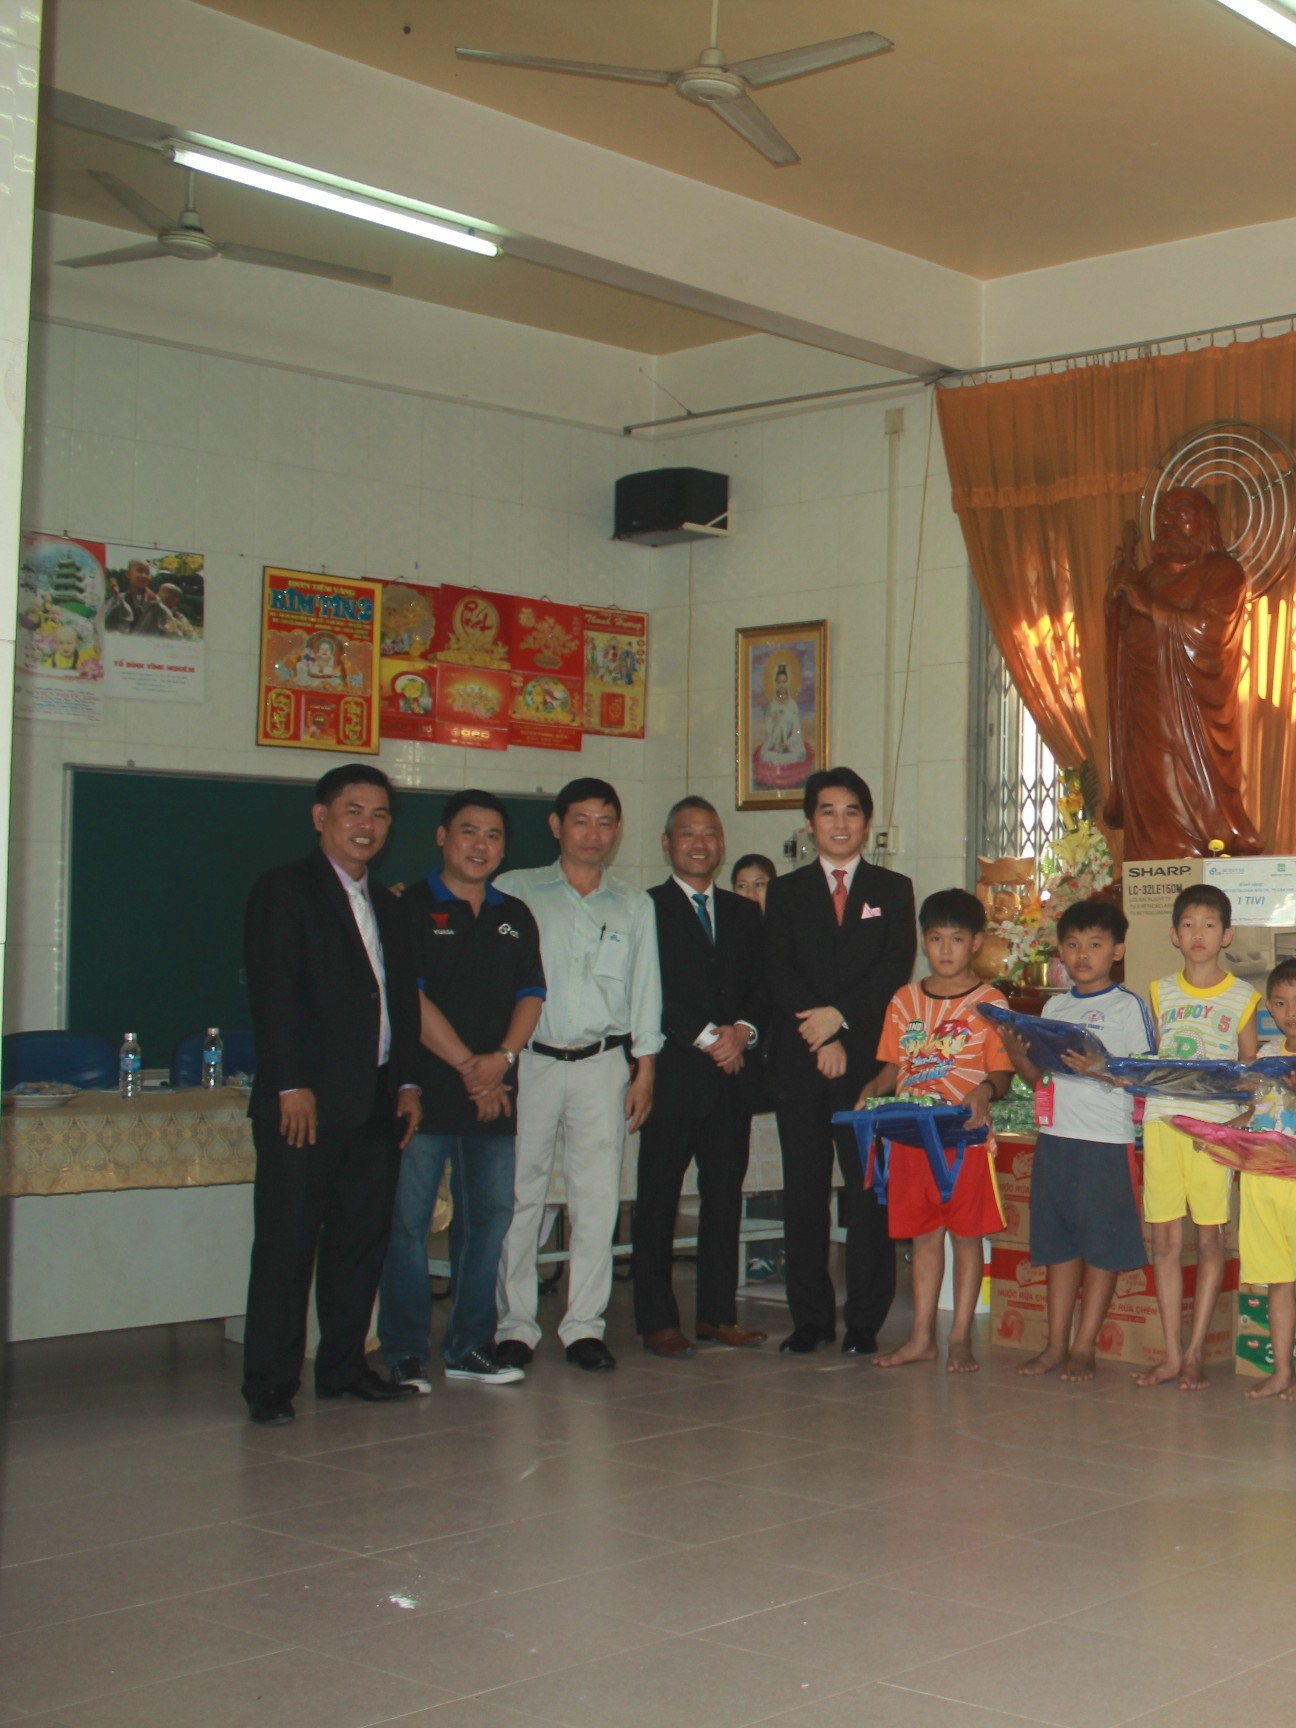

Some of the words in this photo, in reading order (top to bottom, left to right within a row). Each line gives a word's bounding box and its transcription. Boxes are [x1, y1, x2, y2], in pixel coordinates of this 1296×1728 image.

[358, 597, 374, 623] 2
[1128, 865, 1191, 878] SHARP
[1245, 896, 1265, 905] TIVI
[1218, 1015, 1232, 1034] 5
